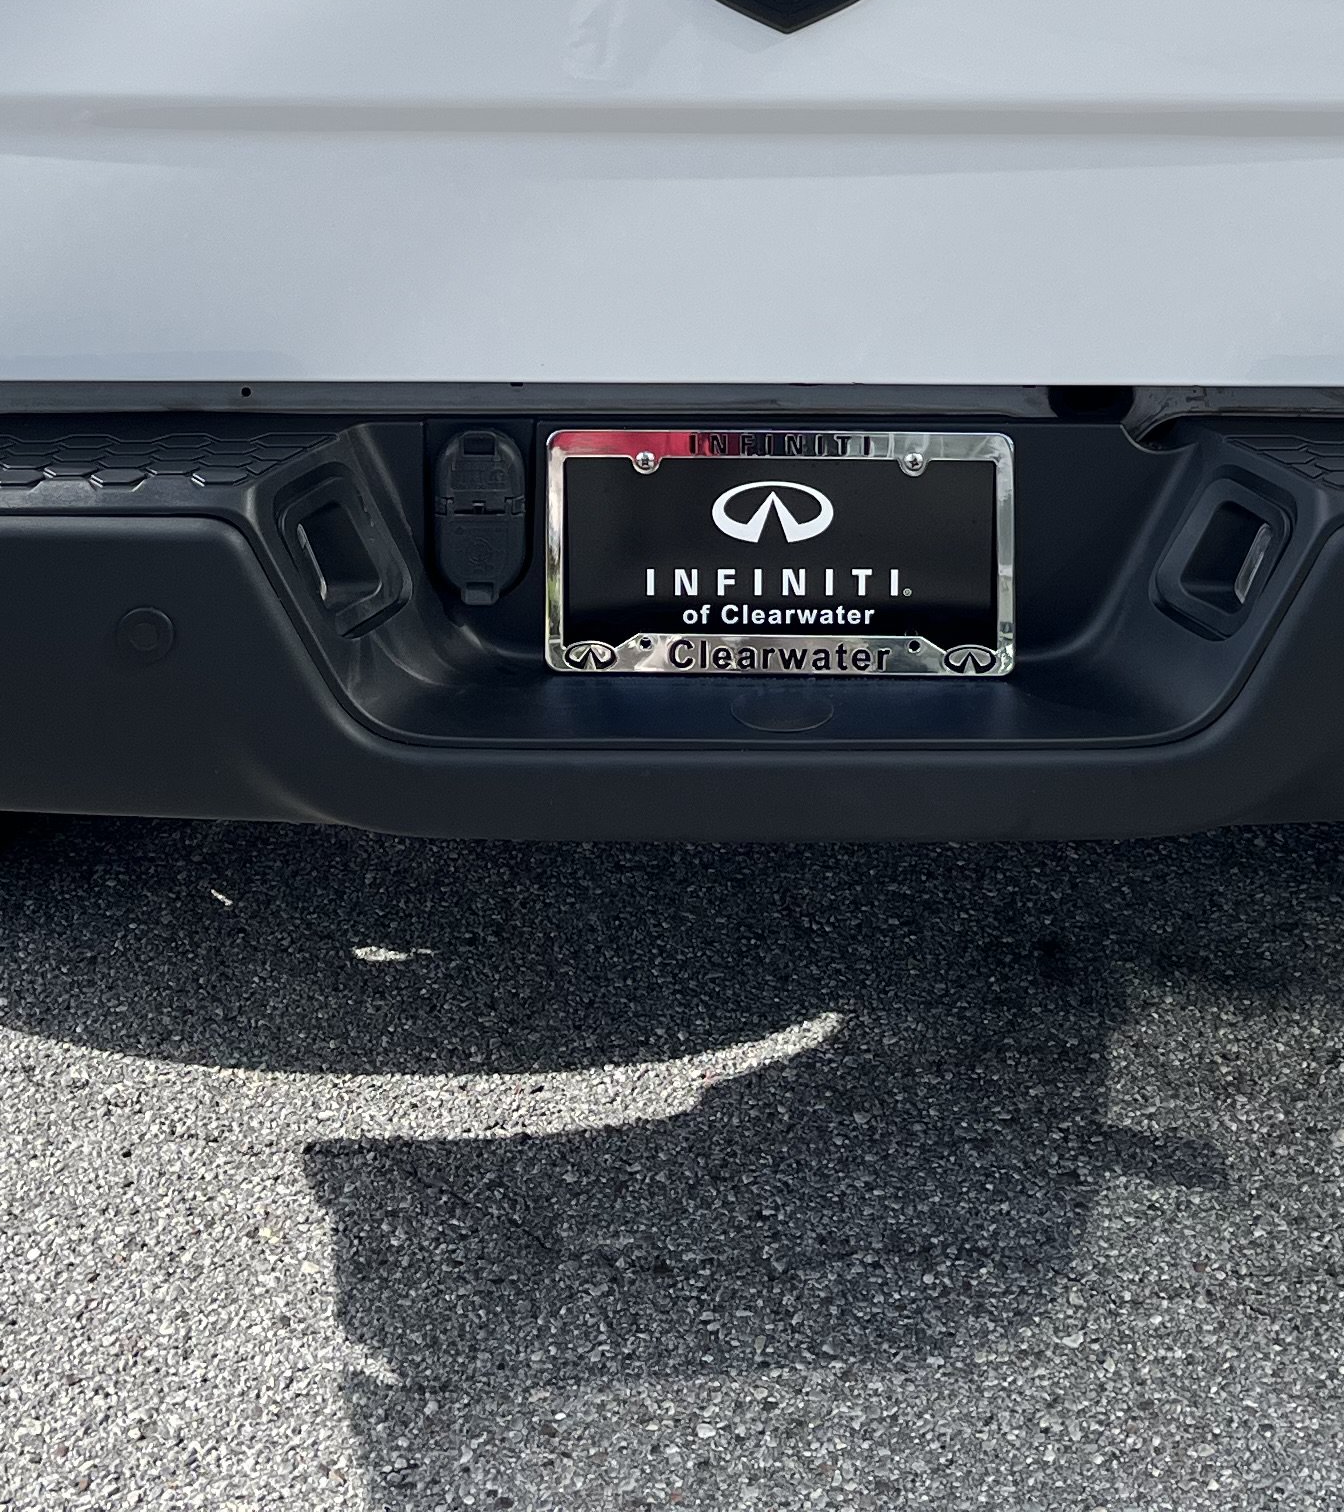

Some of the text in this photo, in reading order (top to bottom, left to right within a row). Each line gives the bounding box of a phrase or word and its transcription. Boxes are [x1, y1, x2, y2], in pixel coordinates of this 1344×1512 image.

[689, 433, 872, 456] INFINITI
[682, 604, 875, 625] of Clearwater
[668, 639, 891, 672] Clearwater
